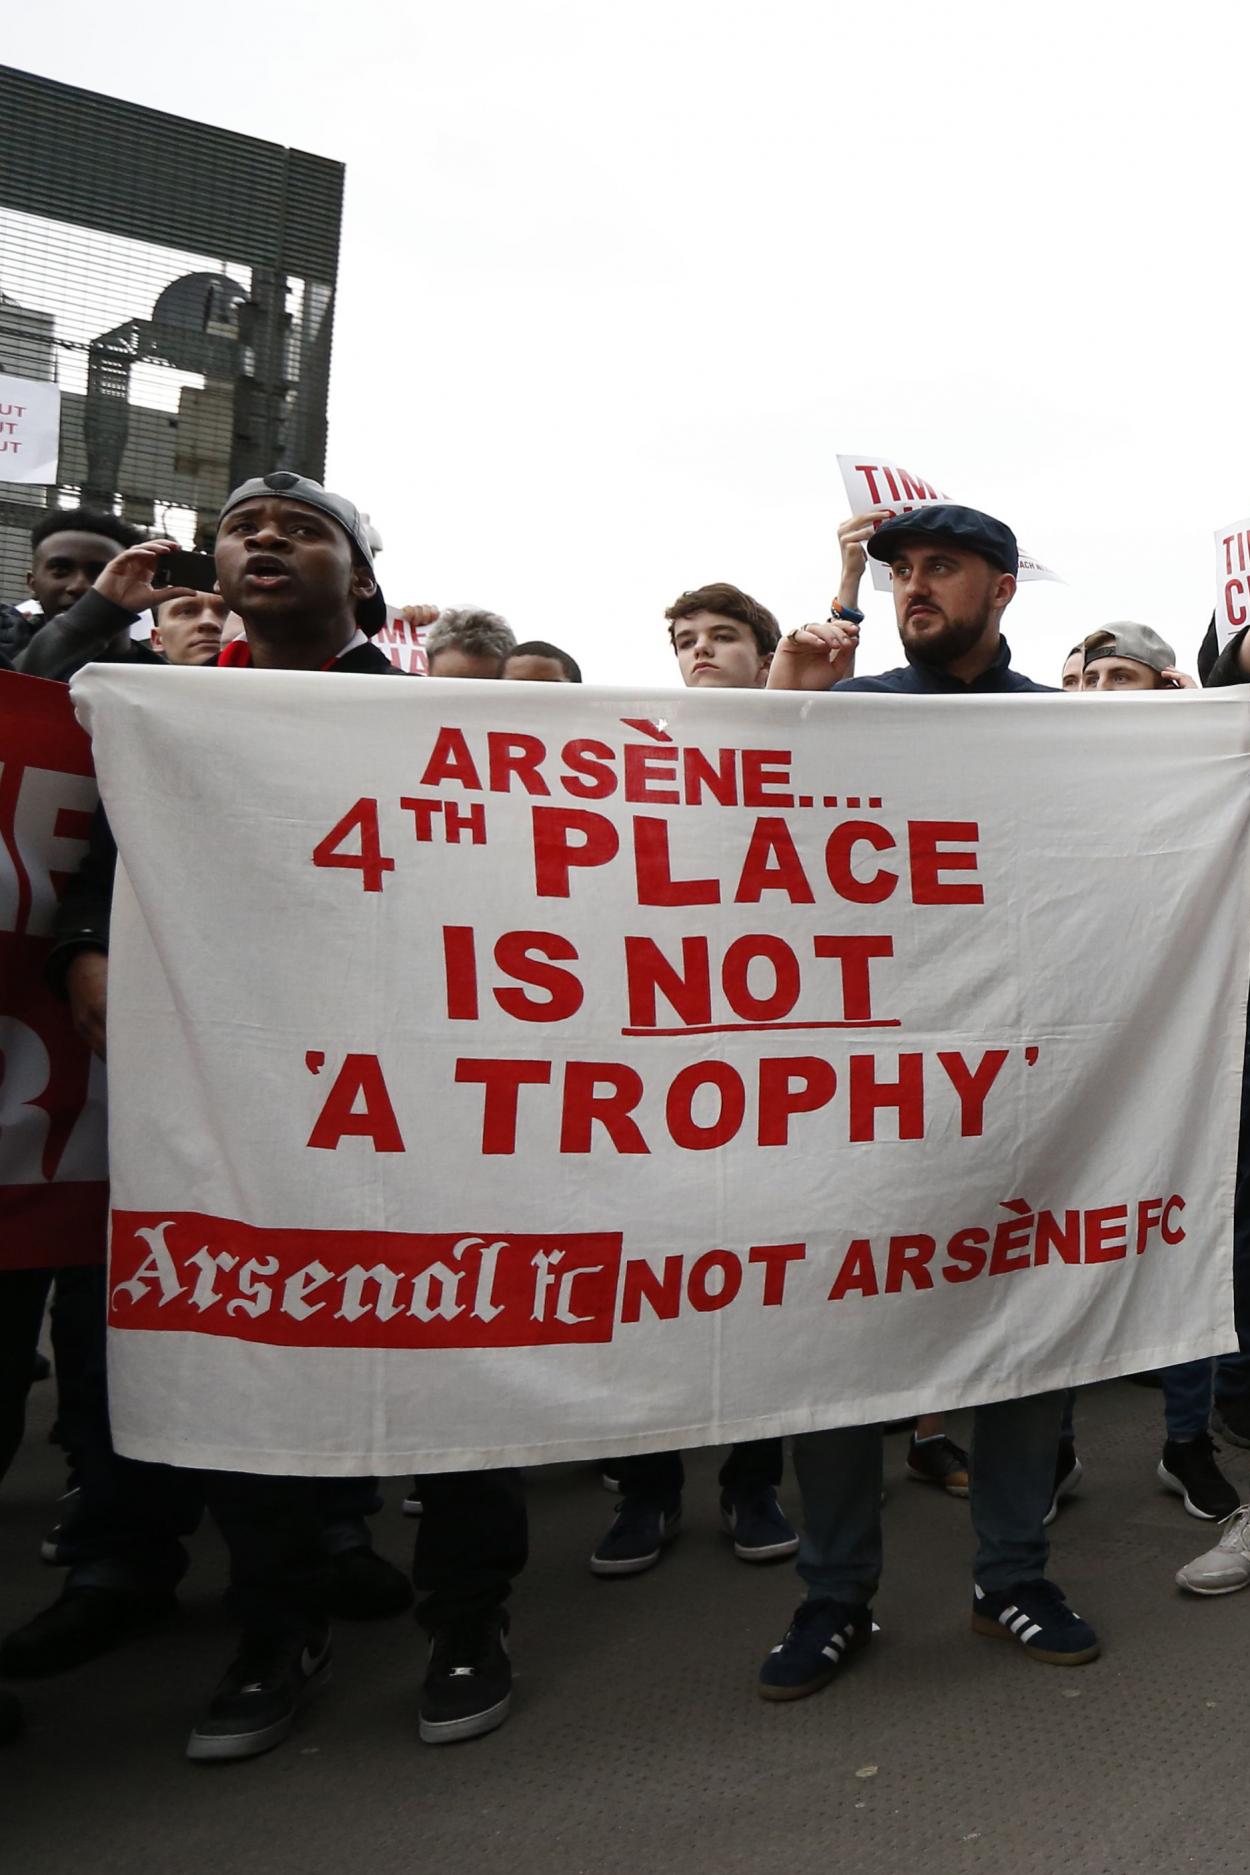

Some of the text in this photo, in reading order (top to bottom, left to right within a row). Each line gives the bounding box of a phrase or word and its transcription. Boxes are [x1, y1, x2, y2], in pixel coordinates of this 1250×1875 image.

[855, 465, 952, 504] TIM
[311, 797, 985, 906] 4TH PLACE
[442, 925, 894, 1029] IS NOT
[112, 1221, 506, 1325] Arsenal
[619, 1243, 809, 1325] NOT
[828, 1198, 1128, 1302] ARSÈNE
[1137, 1195, 1188, 1256] FC
